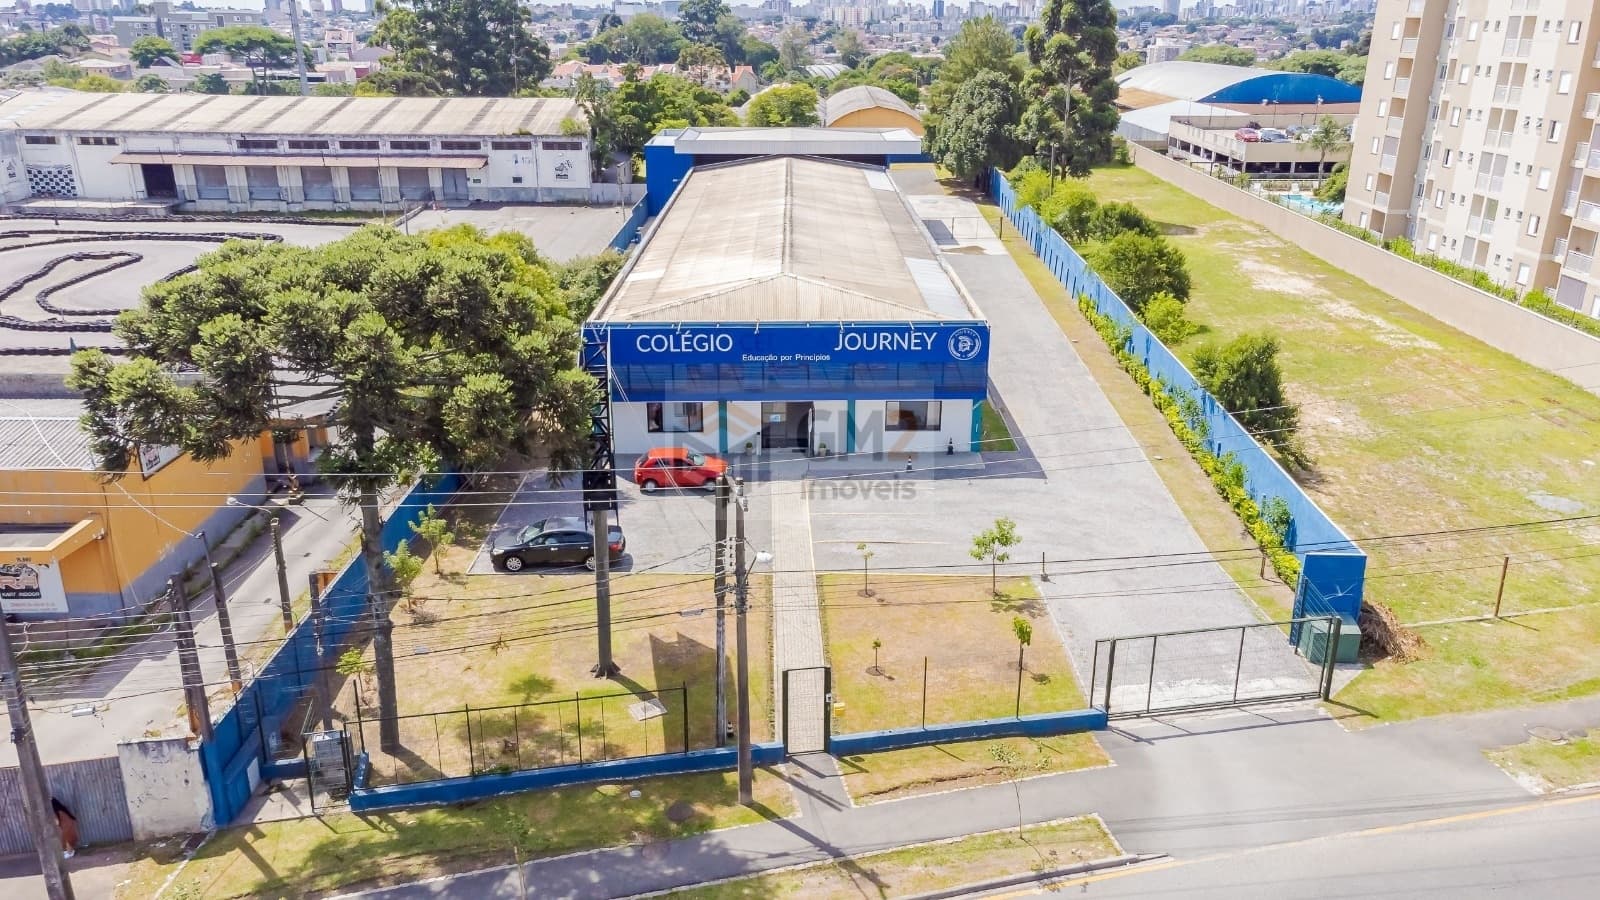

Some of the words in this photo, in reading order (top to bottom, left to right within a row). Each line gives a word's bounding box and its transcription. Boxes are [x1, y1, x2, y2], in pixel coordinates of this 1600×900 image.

[636, 330, 734, 353] COLÉGIO
[834, 331, 939, 351] JOURNEY
[742, 353, 778, 362] Educação
